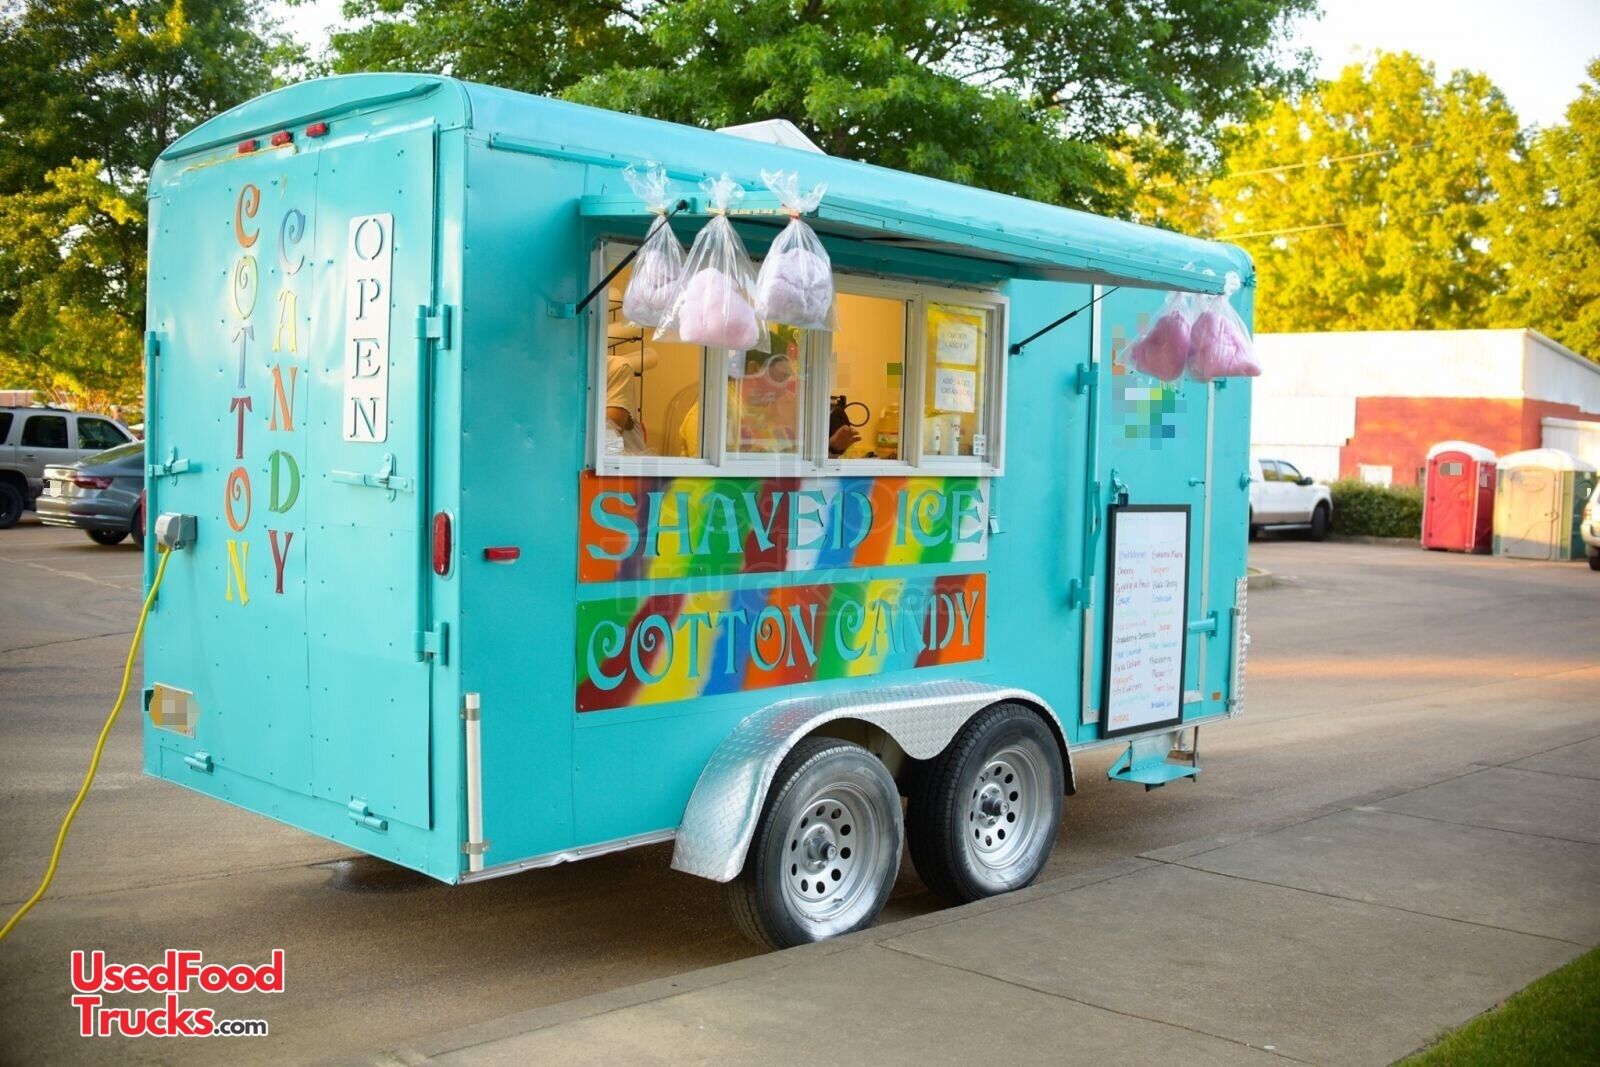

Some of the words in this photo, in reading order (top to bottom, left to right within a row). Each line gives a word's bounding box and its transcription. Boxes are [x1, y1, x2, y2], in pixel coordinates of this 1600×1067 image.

[225, 184, 260, 606] COTTON
[268, 208, 306, 594] CANDY
[350, 218, 384, 439] OPEN
[586, 489, 874, 561] SHAVED
[896, 488, 985, 546] ICE
[587, 604, 820, 691] COTTON
[834, 590, 980, 662] CANDY
